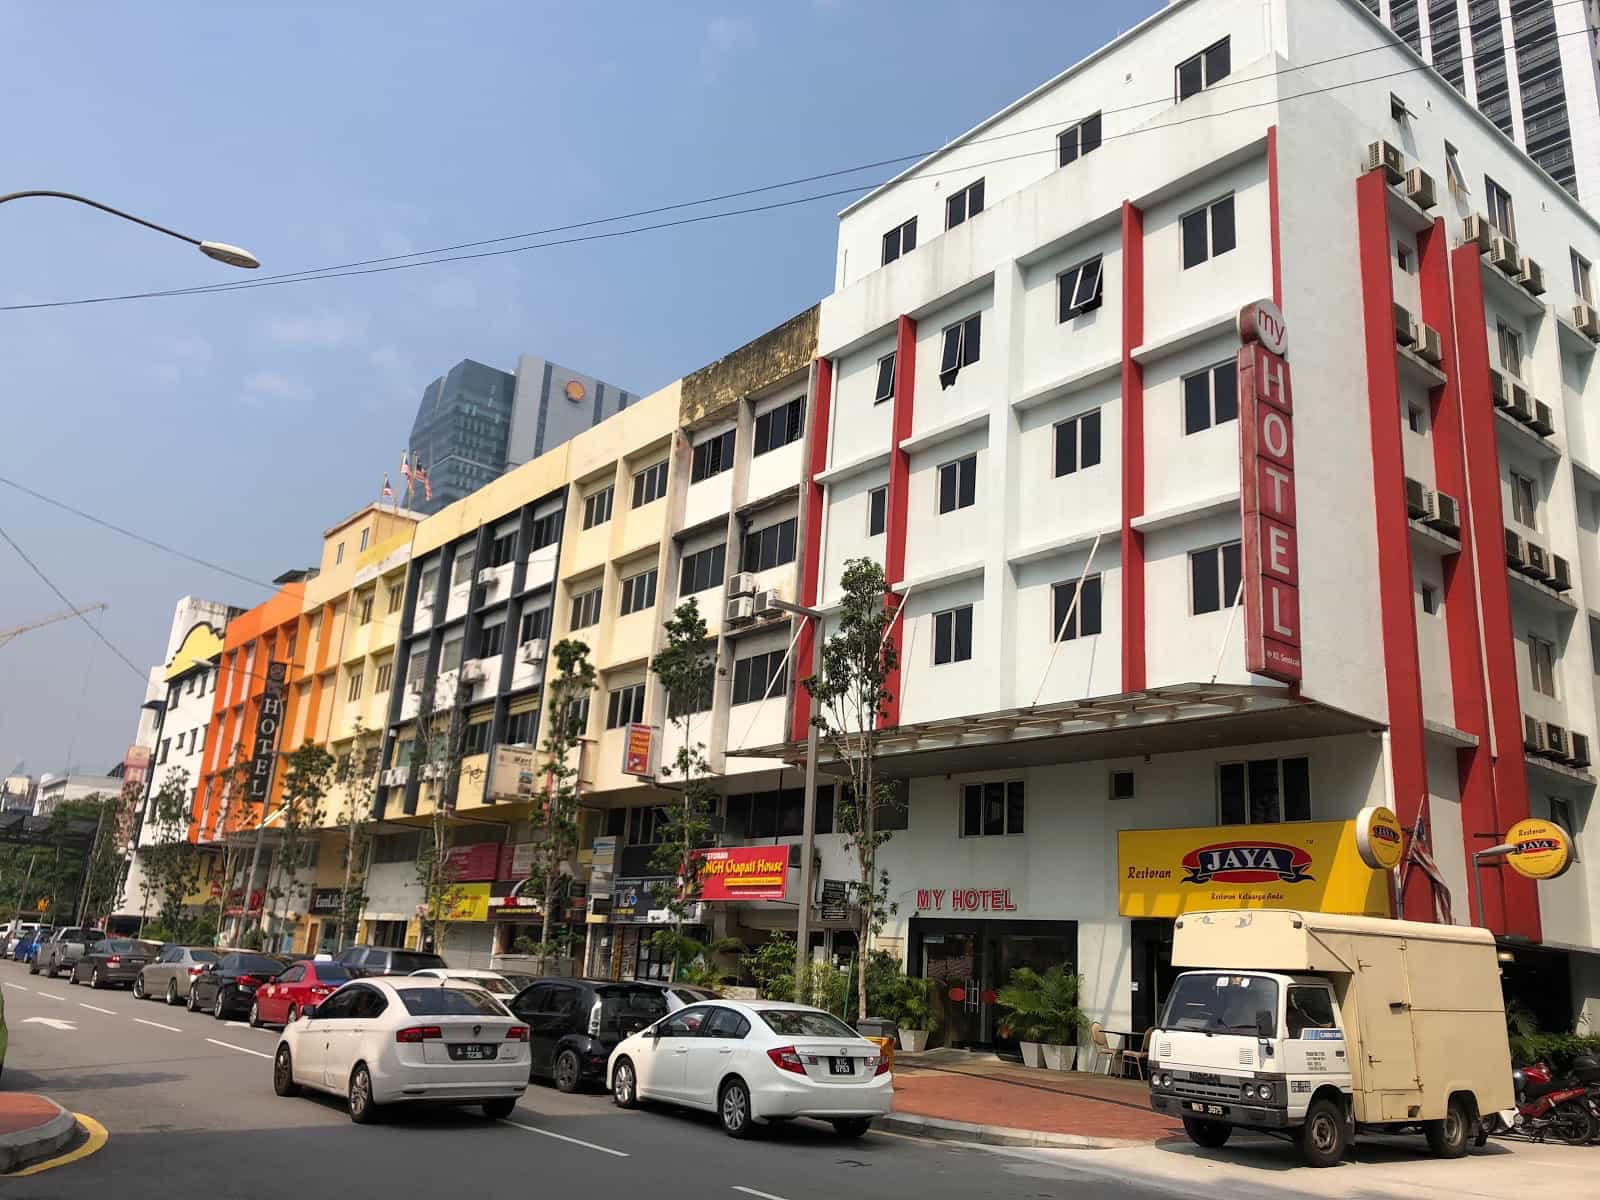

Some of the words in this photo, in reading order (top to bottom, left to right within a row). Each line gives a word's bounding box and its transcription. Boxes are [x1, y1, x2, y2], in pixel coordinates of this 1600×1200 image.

[1258, 308, 1285, 346] my
[1261, 355, 1293, 637] HOTEL
[251, 698, 279, 796] HOTEL
[1521, 840, 1550, 851] JAYA
[758, 858, 784, 873] House
[1207, 848, 1280, 872] JAYA
[1127, 866, 1171, 880] Restoran
[916, 888, 945, 911] MY
[951, 888, 1017, 912] HOTEL
